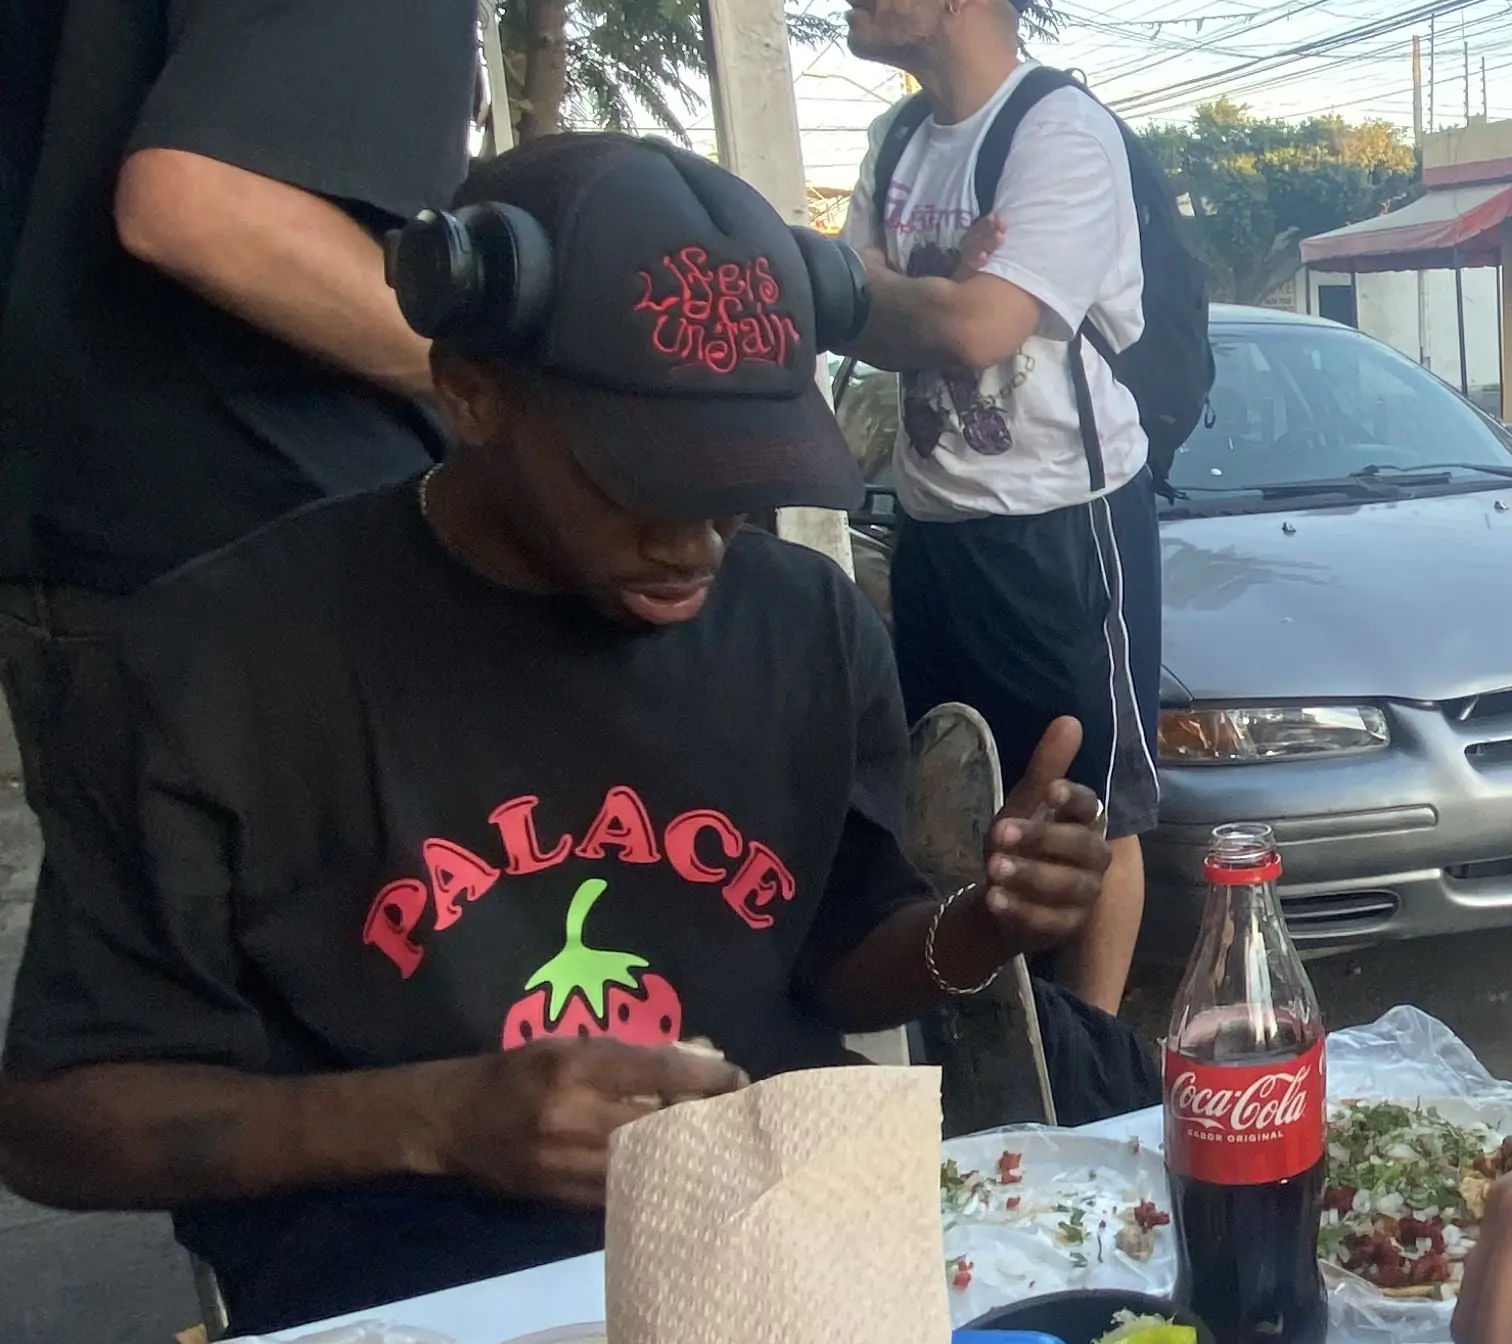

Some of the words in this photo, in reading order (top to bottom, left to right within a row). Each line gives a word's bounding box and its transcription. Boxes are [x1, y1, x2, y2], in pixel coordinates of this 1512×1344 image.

[363, 785, 796, 979] PALACE
[1171, 1063, 1311, 1131] Coca-Cola
[1187, 1129, 1223, 1143] SABOR
[1227, 1130, 1285, 1144] ORIGINAL
